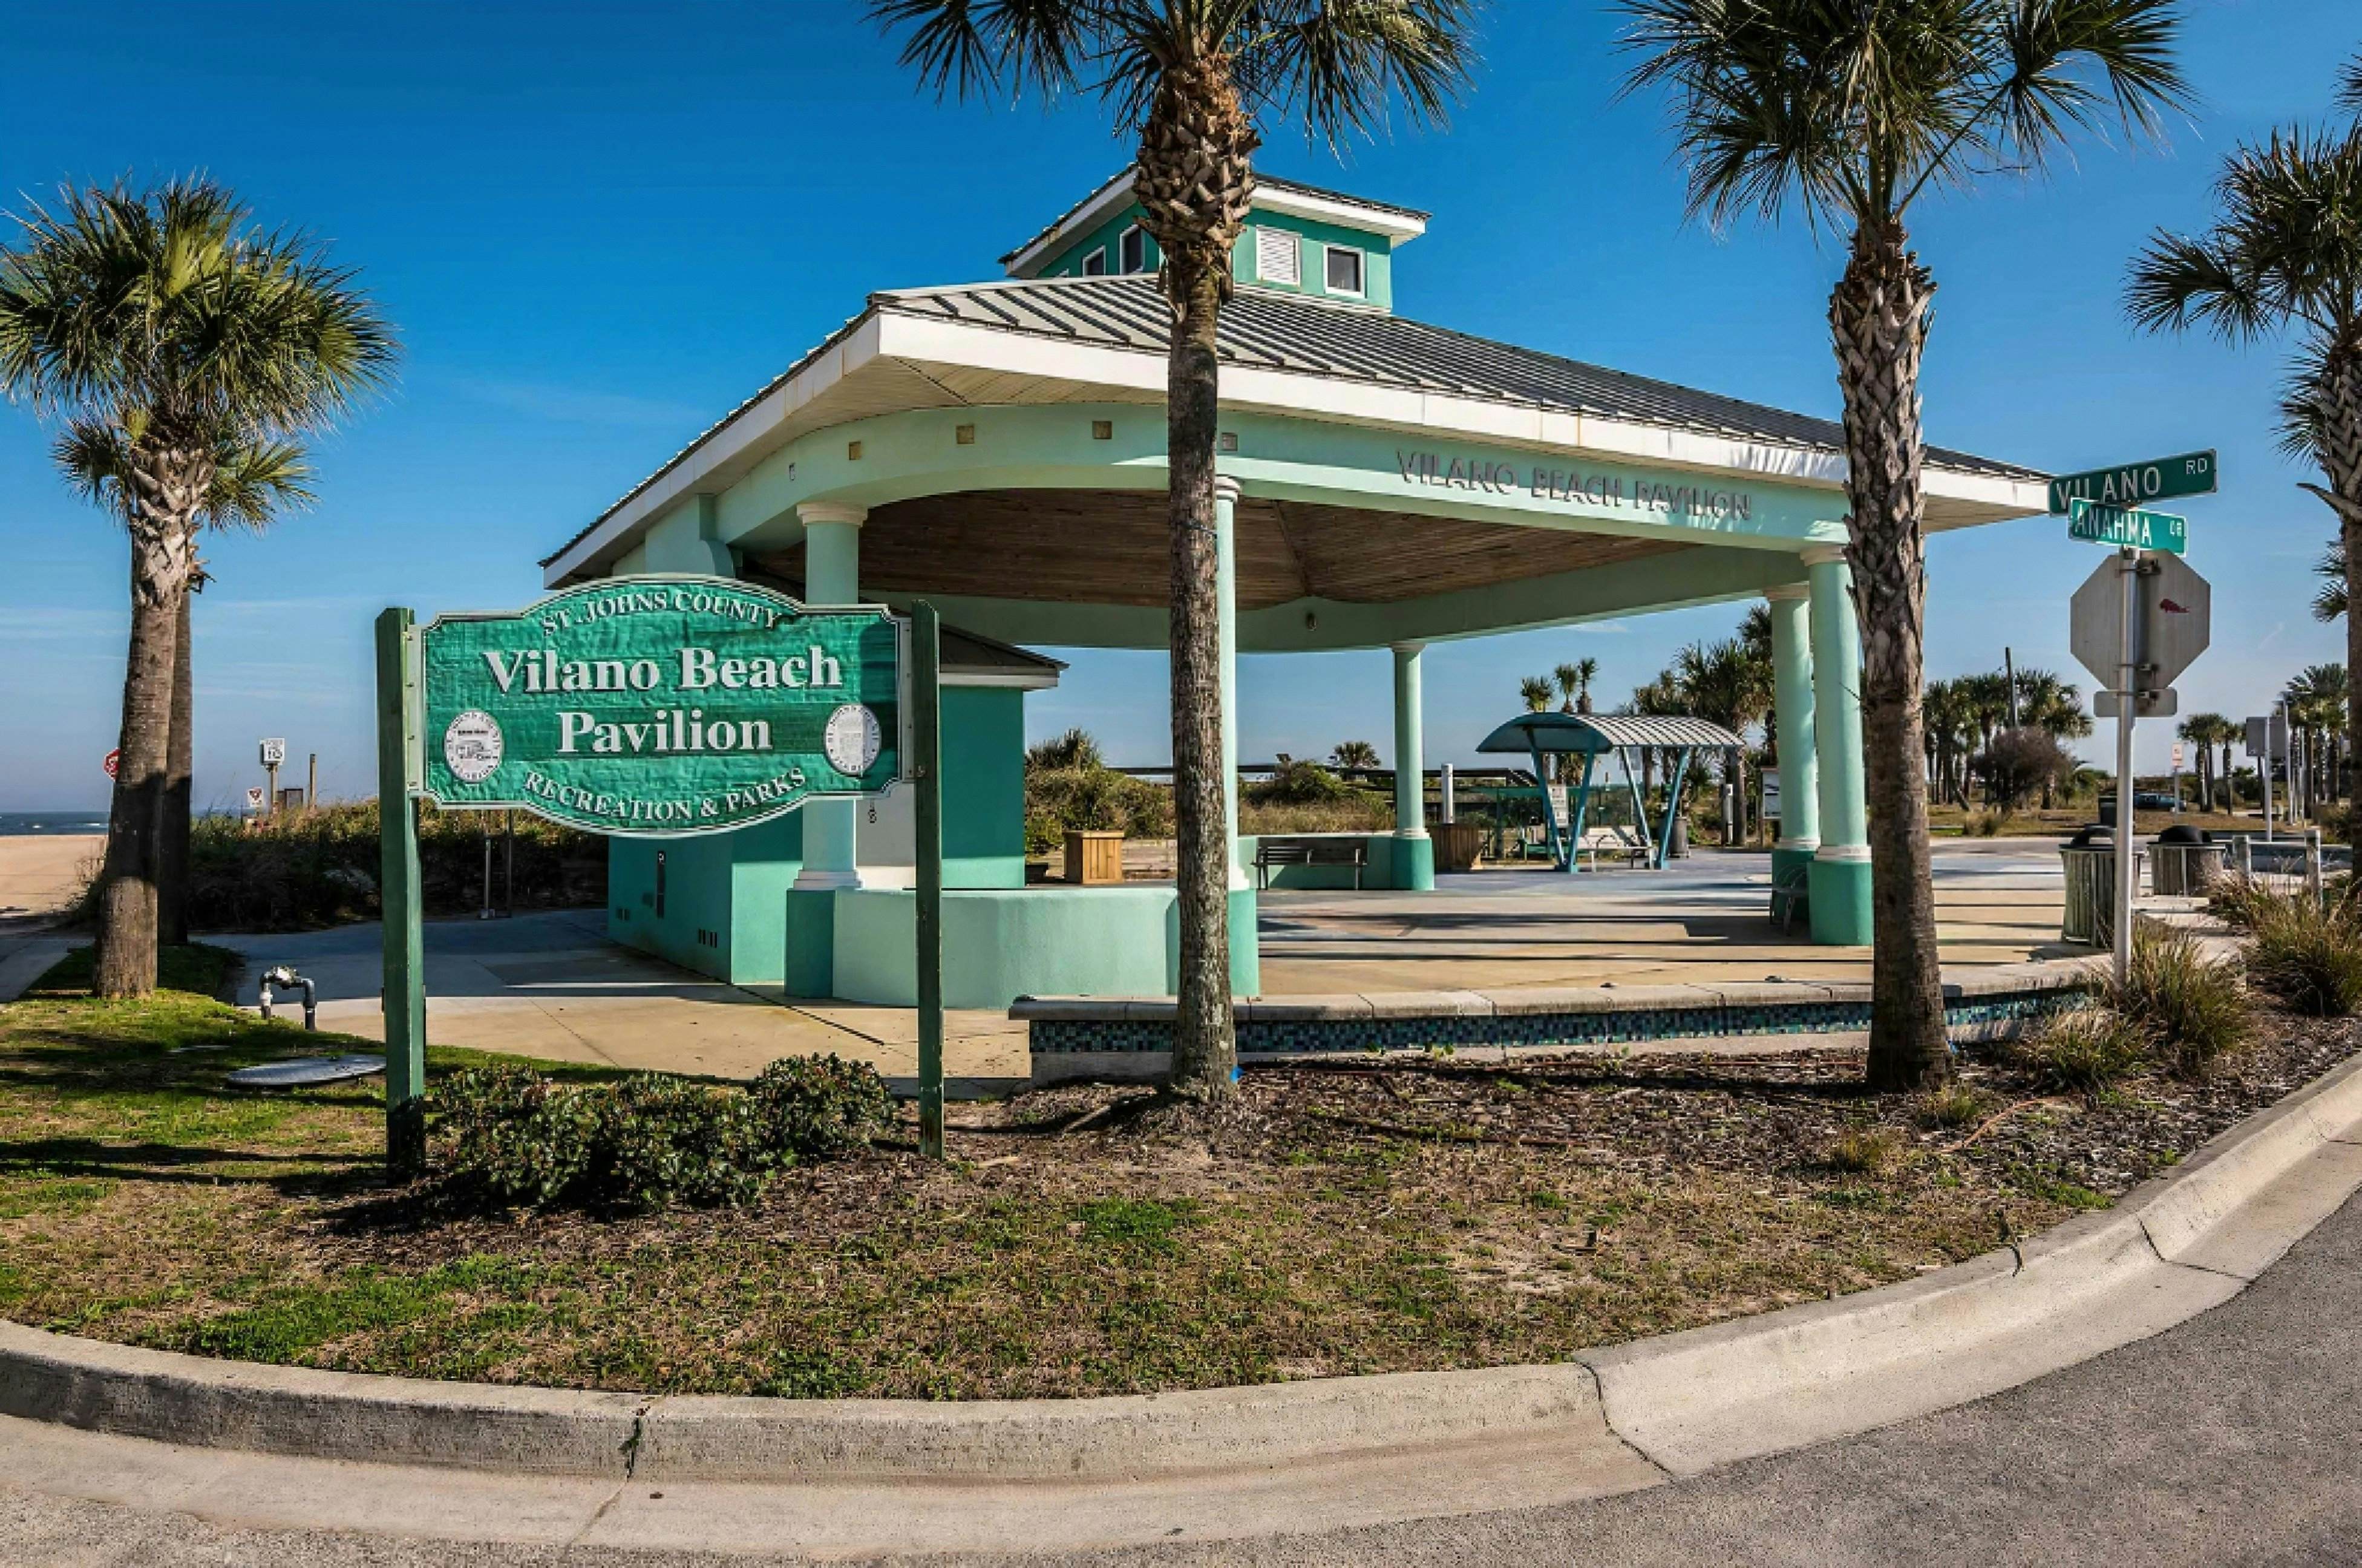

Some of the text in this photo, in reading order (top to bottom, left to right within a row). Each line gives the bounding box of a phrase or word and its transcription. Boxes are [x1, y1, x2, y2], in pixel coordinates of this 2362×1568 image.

[1396, 449, 1752, 521] VILANO BEACH PAVILION
[2056, 457, 2207, 509] VILANO RD
[584, 592, 667, 624] JOHNS
[675, 592, 782, 629] COUNTY
[483, 645, 843, 693] Vilano Beach
[555, 709, 773, 753] Pavilion
[525, 767, 806, 820] RECREATION & PARKS
